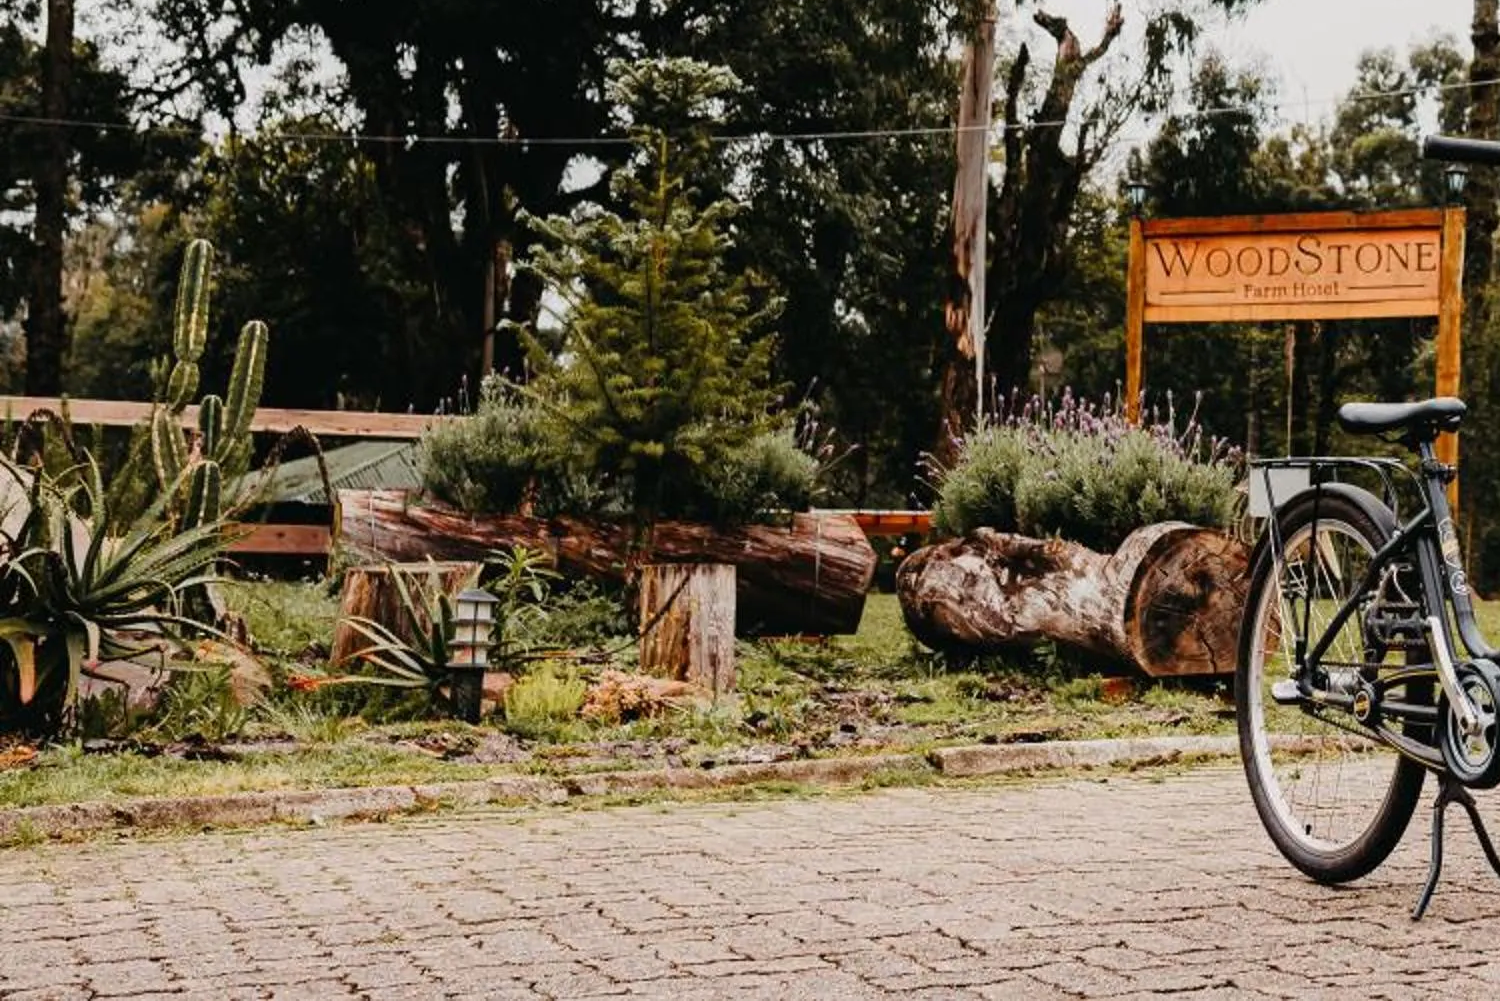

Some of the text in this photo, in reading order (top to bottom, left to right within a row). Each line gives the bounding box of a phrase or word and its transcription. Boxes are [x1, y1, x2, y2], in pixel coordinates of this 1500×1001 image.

[1153, 235, 1437, 278] WOODSTONE
[1243, 281, 1340, 298] Farm Hotel
